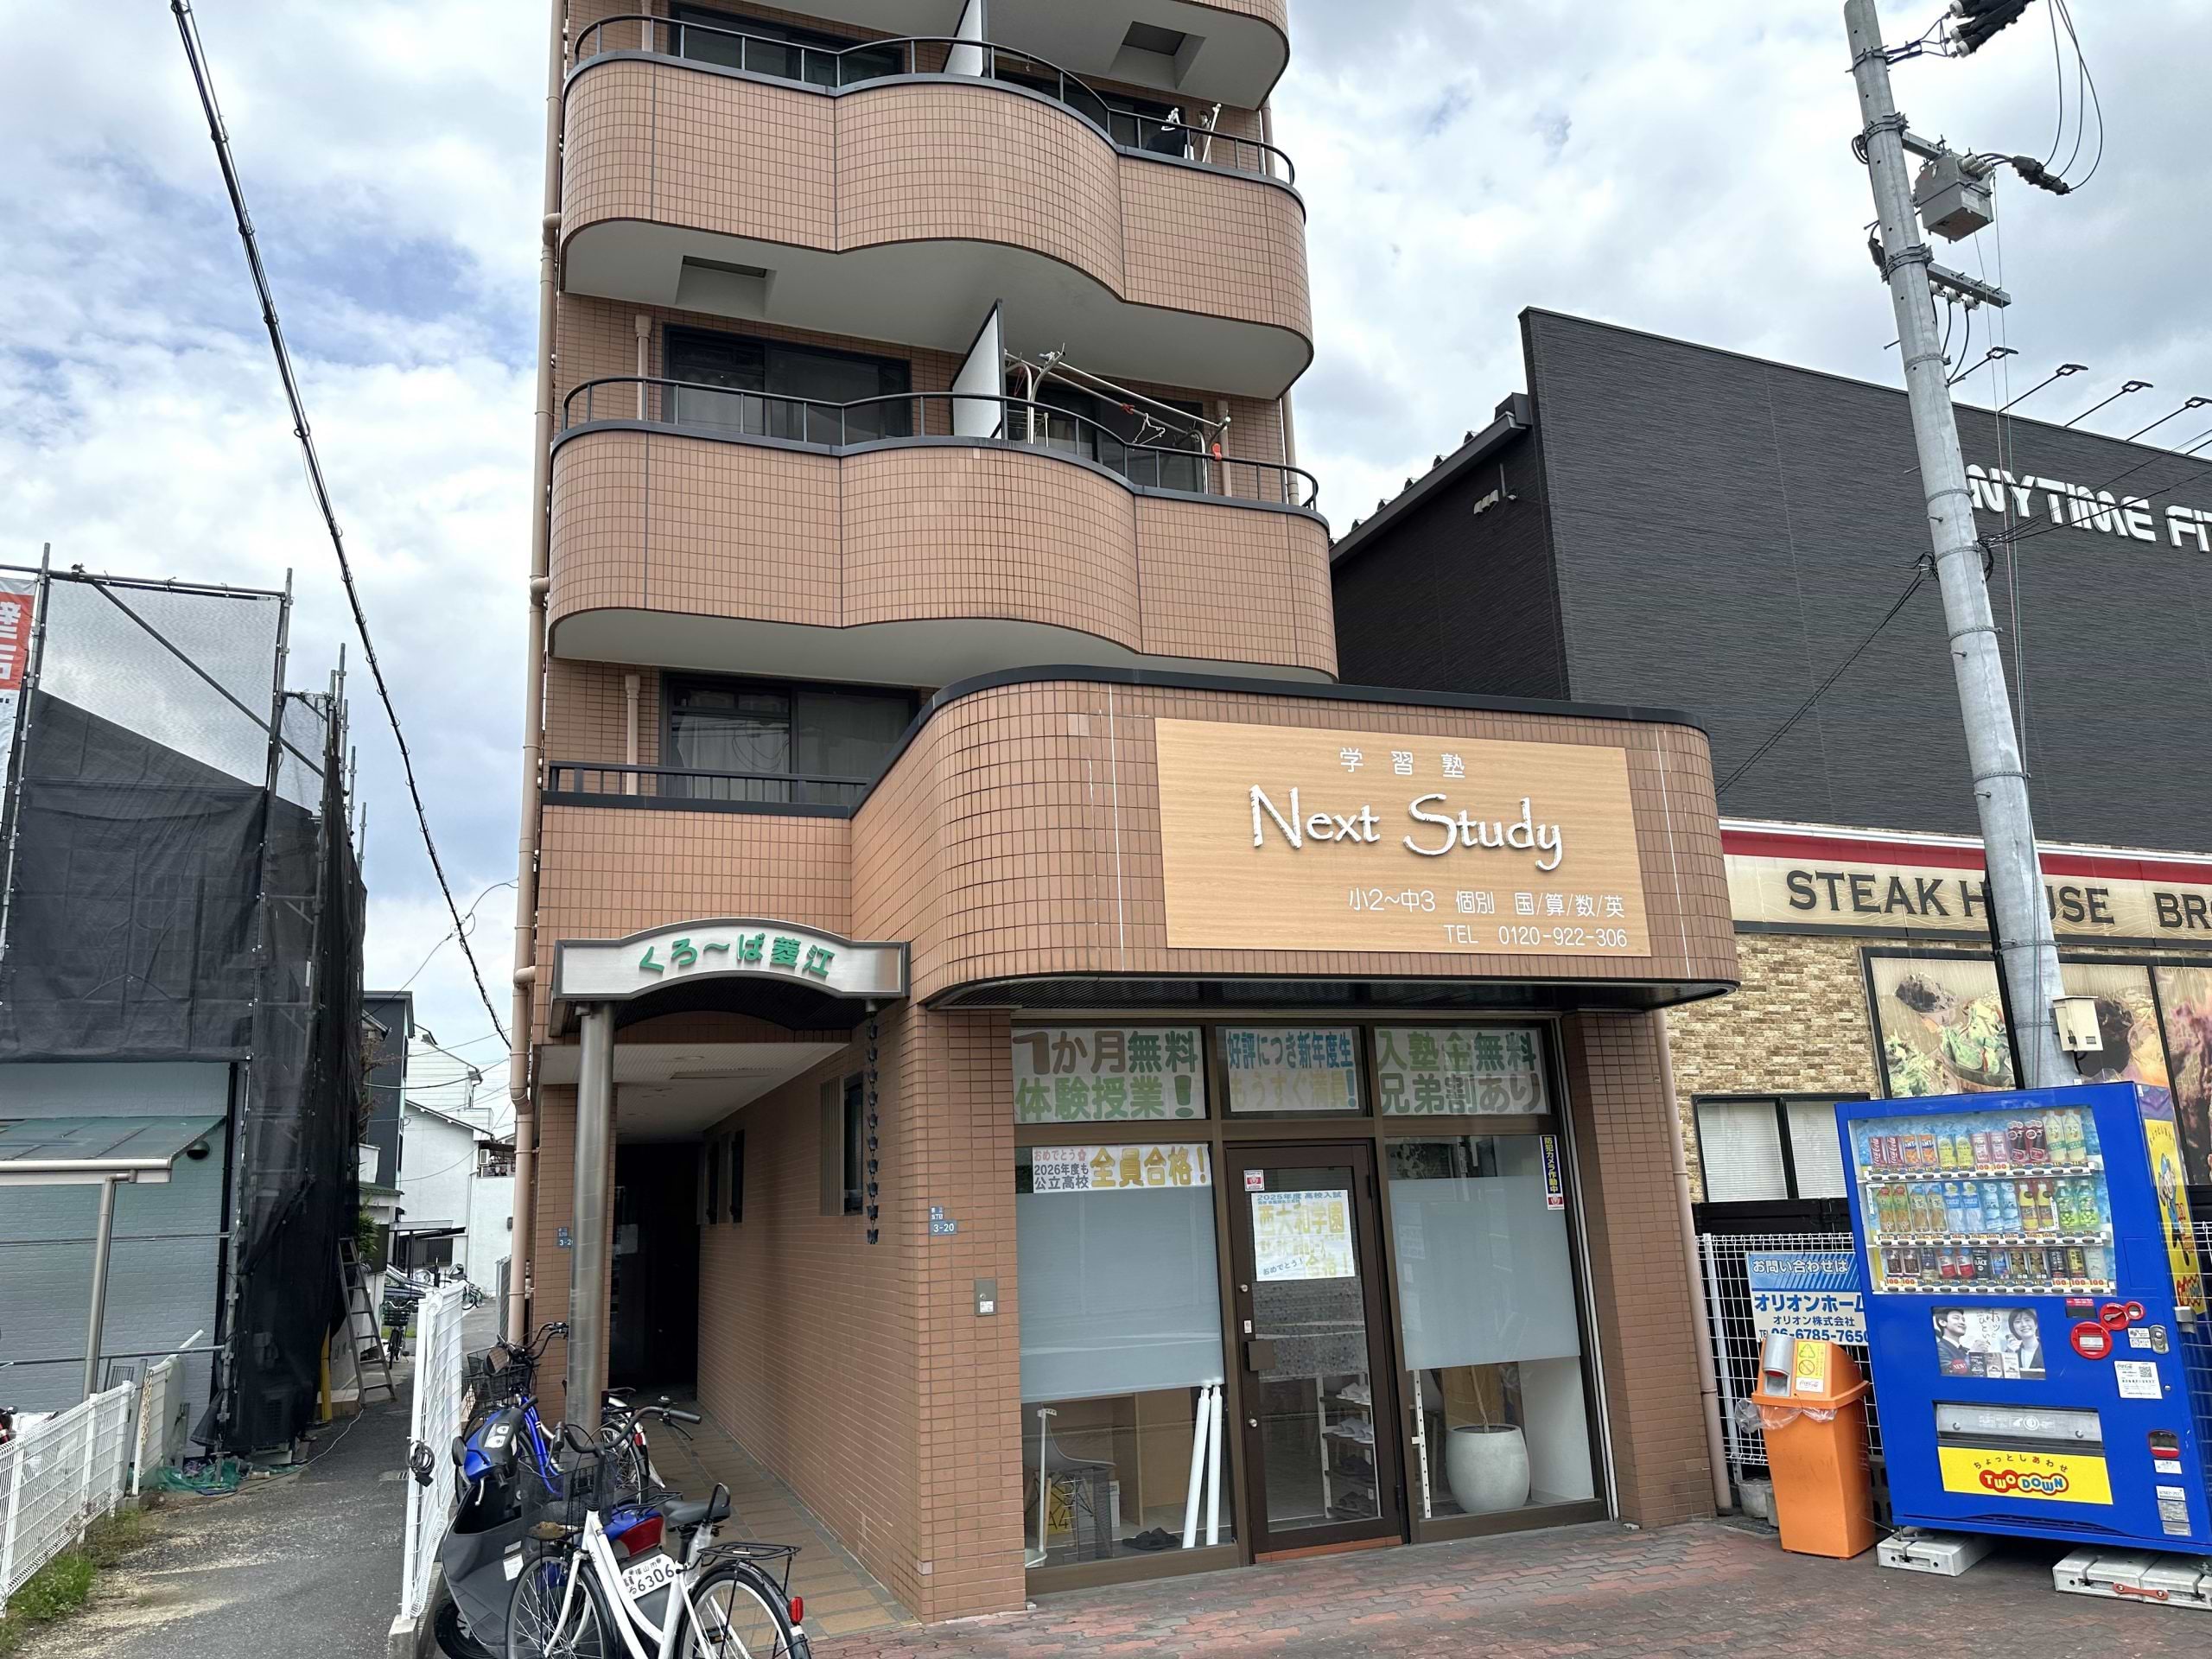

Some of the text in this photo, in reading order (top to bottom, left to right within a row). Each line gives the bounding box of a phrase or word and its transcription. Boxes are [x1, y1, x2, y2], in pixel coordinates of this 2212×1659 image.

[1966, 464, 2212, 553] NYTIME FI
[1339, 747, 1465, 778] 学習塾
[1249, 784, 1564, 871] Next Study
[1455, 890, 1495, 914] 個別
[1514, 892, 1625, 918] 国/算/数/英
[1786, 870, 2212, 930] STEAK HSE BR
[1443, 924, 1628, 947] TEL 0120-922-306
[1012, 1030, 1198, 1075] 1か月無料
[1227, 1030, 1354, 1069] 好評につき新年度生
[1377, 1030, 1537, 1072] 入塾金無料
[1014, 1075, 1194, 1122] 体験授業！
[1379, 1072, 1541, 1114] 兄弟割あり
[1033, 1163, 1089, 1176] 2026年度も
[1090, 1146, 1206, 1188] 全員合格！
[1543, 1136, 1559, 1193] 防犯カメラ作動中
[1034, 1175, 1090, 1190] 公立高校
[1257, 1192, 1302, 1201] 2025年度
[933, 1223, 955, 1233] 3-20
[1752, 1259, 1849, 1274] お問い合わせは
[1773, 1315, 1855, 1326] オリオン株式会社
[1974, 1454, 2069, 1472] ちょっとしあわせ
[1984, 1474, 2063, 1492] TWO DOWN
[638, 1563, 675, 1592] 6306
